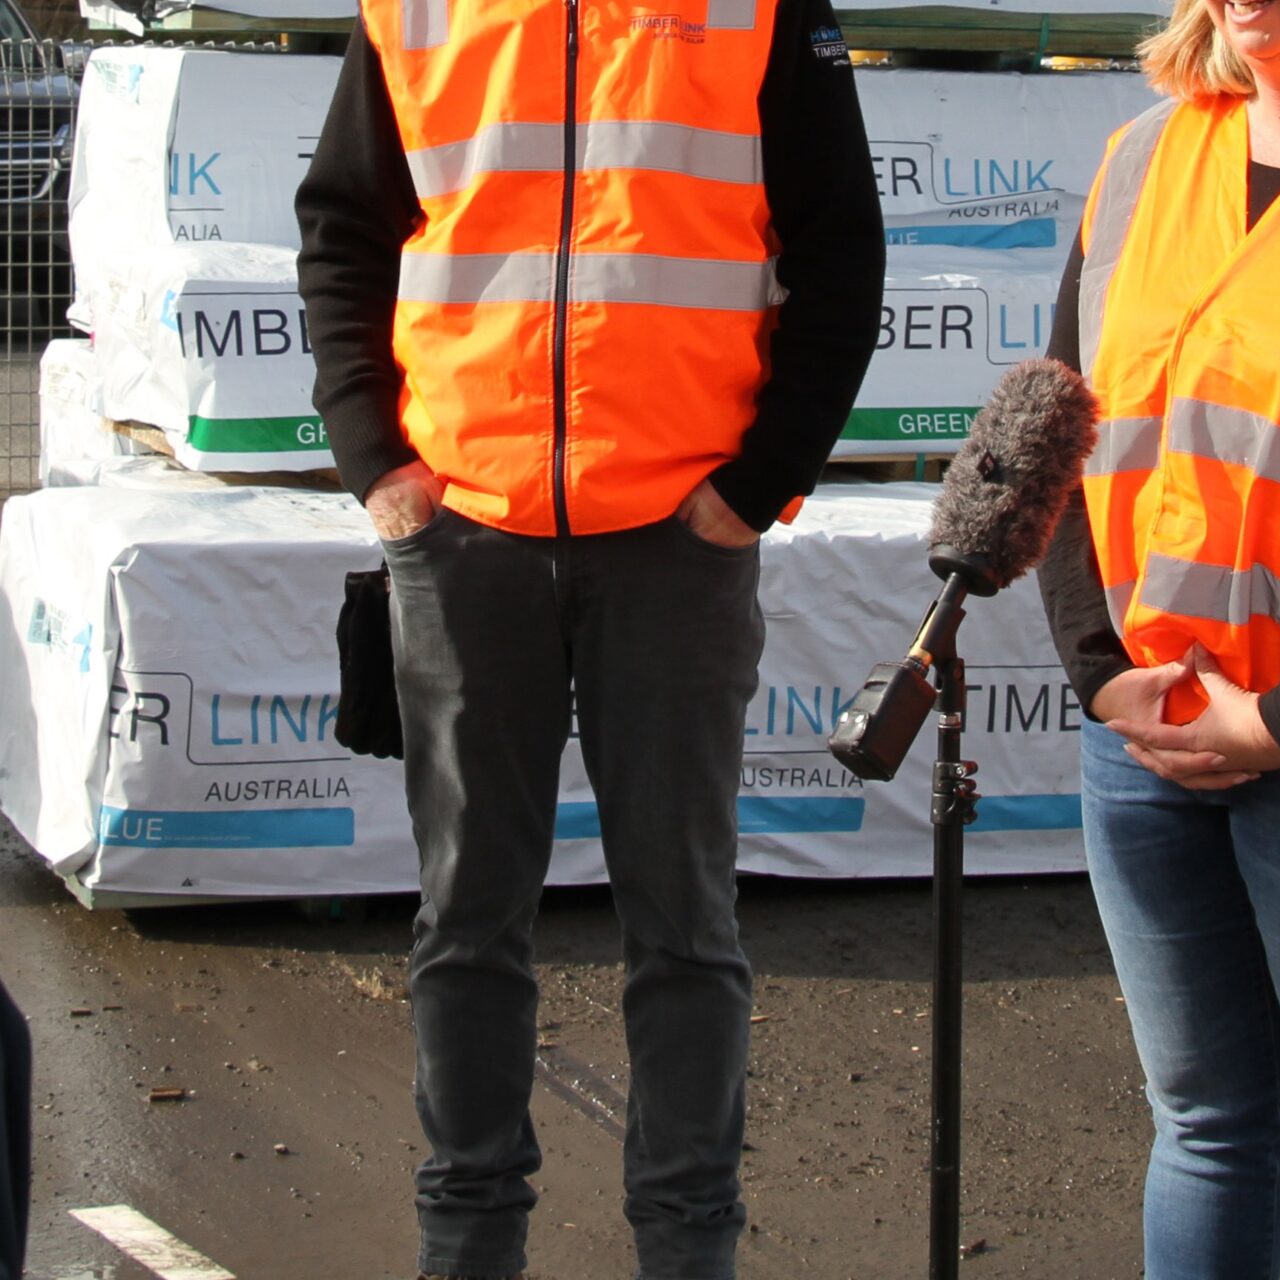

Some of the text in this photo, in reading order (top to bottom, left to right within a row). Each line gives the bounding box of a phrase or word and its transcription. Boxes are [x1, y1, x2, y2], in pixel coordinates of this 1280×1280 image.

[813, 45, 847, 58] TIMBER
[944, 158, 1054, 196] LINK
[205, 777, 351, 802] AUSTRALIA
